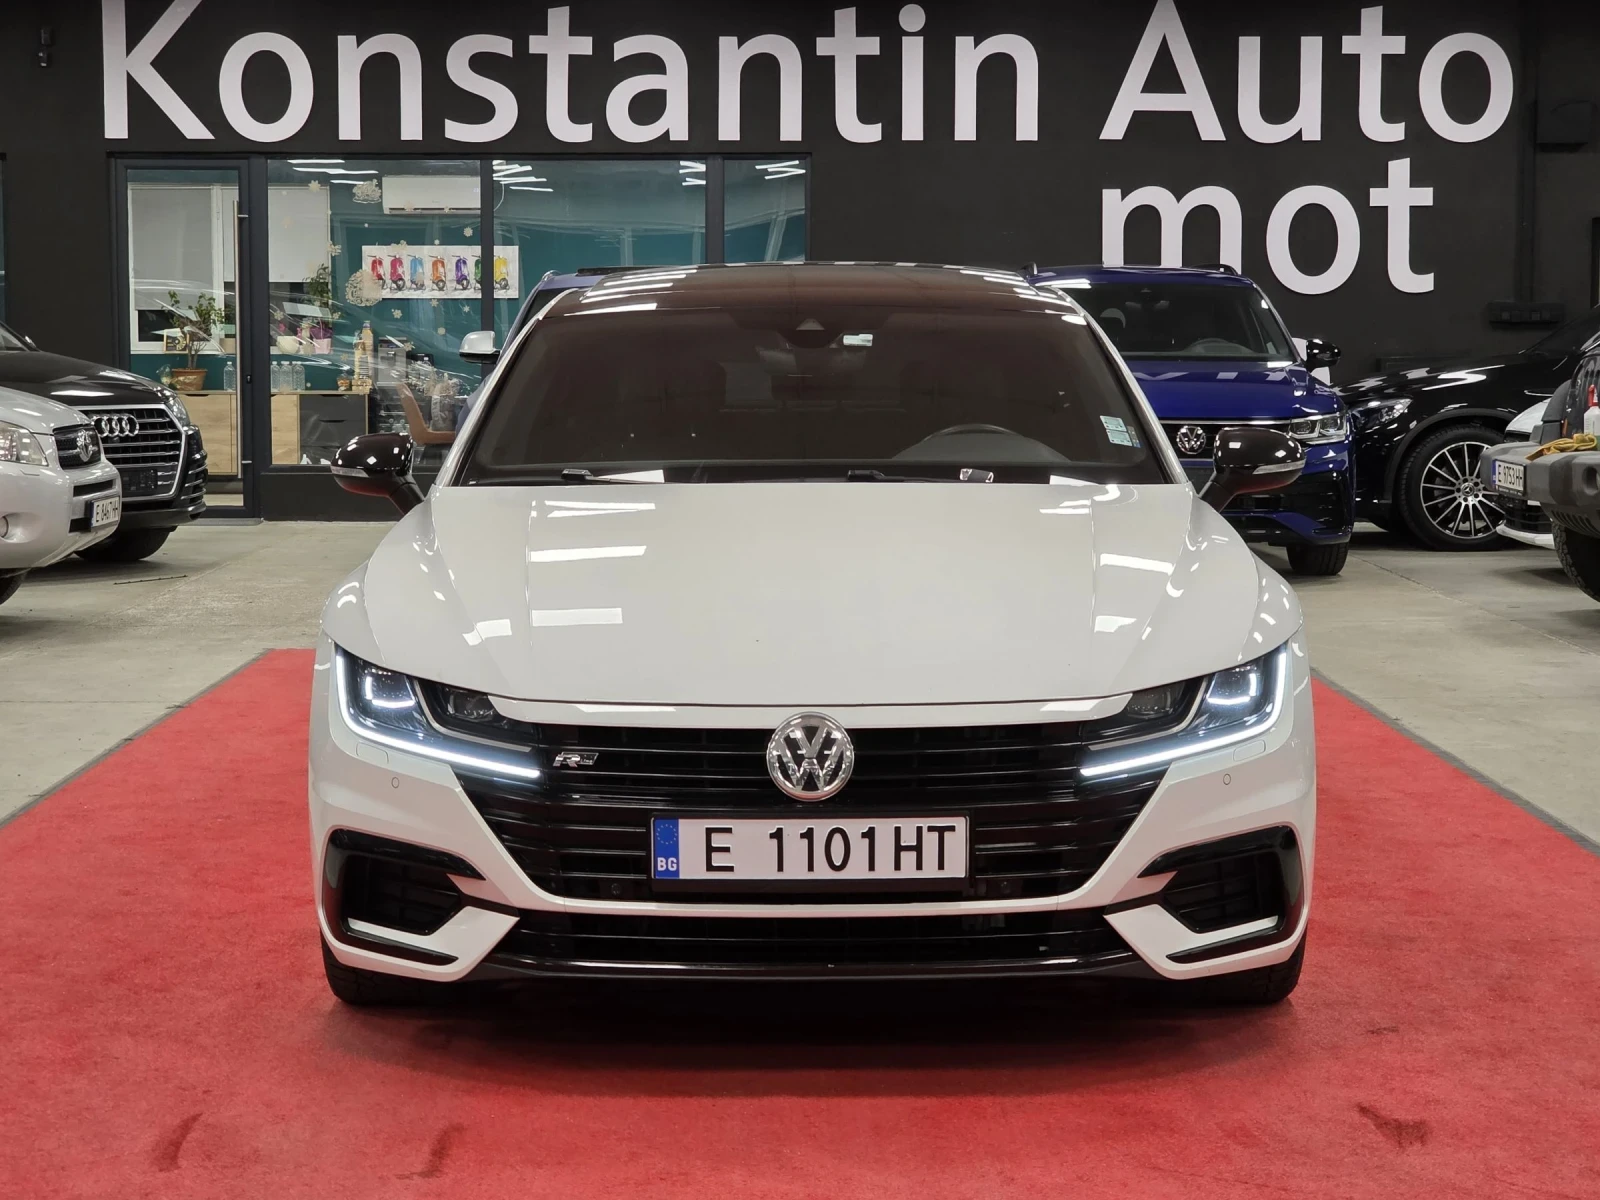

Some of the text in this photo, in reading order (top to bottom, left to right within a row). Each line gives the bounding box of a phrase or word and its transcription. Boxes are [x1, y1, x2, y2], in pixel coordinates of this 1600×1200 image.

[103, 0, 1514, 144] Konstantin Auto
[1102, 158, 1435, 295] mot
[657, 857, 677, 871] BG
[705, 827, 734, 872] E
